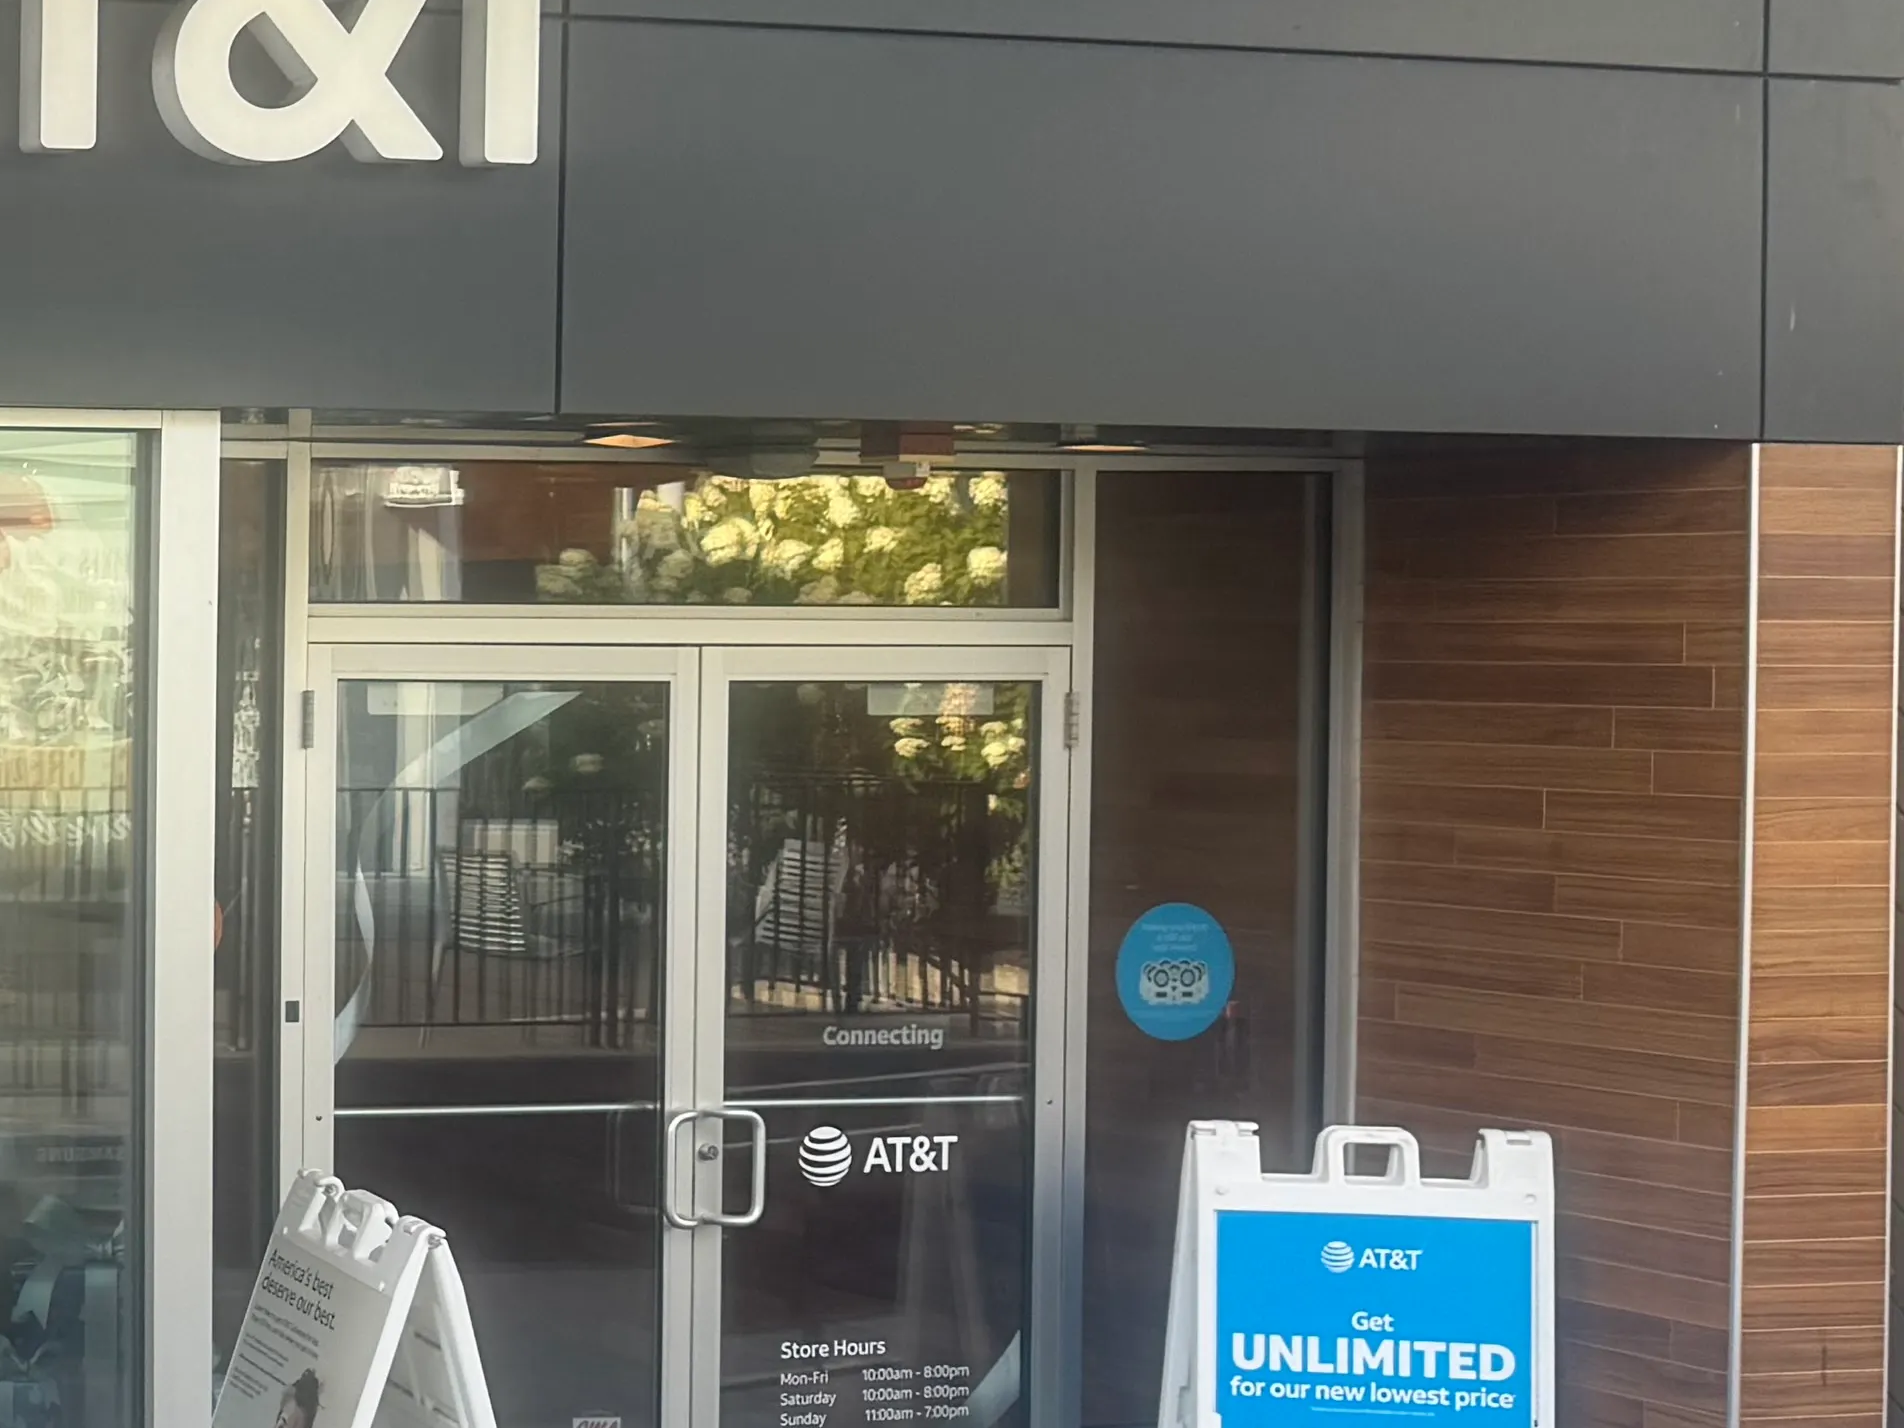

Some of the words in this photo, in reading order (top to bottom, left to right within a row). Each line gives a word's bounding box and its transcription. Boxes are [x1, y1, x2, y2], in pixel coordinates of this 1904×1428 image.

[823, 1024, 944, 1050] Connecting
[863, 1135, 958, 1173] AT&T
[1358, 1249, 1423, 1271] AT&T
[311, 1270, 335, 1300] best
[296, 1296, 314, 1316] our
[1351, 1311, 1394, 1332] Get
[780, 1341, 829, 1359] Store
[834, 1340, 886, 1356] Hours
[1231, 1333, 1516, 1381] UNLIMITED
[780, 1370, 829, 1386] Mon-Fri
[862, 1367, 913, 1382] 10:00am
[923, 1365, 969, 1380] 8:00pm
[780, 1391, 837, 1407] Saturday
[862, 1388, 913, 1402] 10:00am
[923, 1385, 970, 1400] 8:00pm
[1230, 1376, 1264, 1398] for
[1269, 1382, 1310, 1399] our
[1315, 1384, 1365, 1402] new
[1369, 1382, 1450, 1406] lowest
[780, 1412, 827, 1428] Sunday
[865, 1408, 913, 1422] 11:00am
[924, 1405, 969, 1420] 7:00pm
